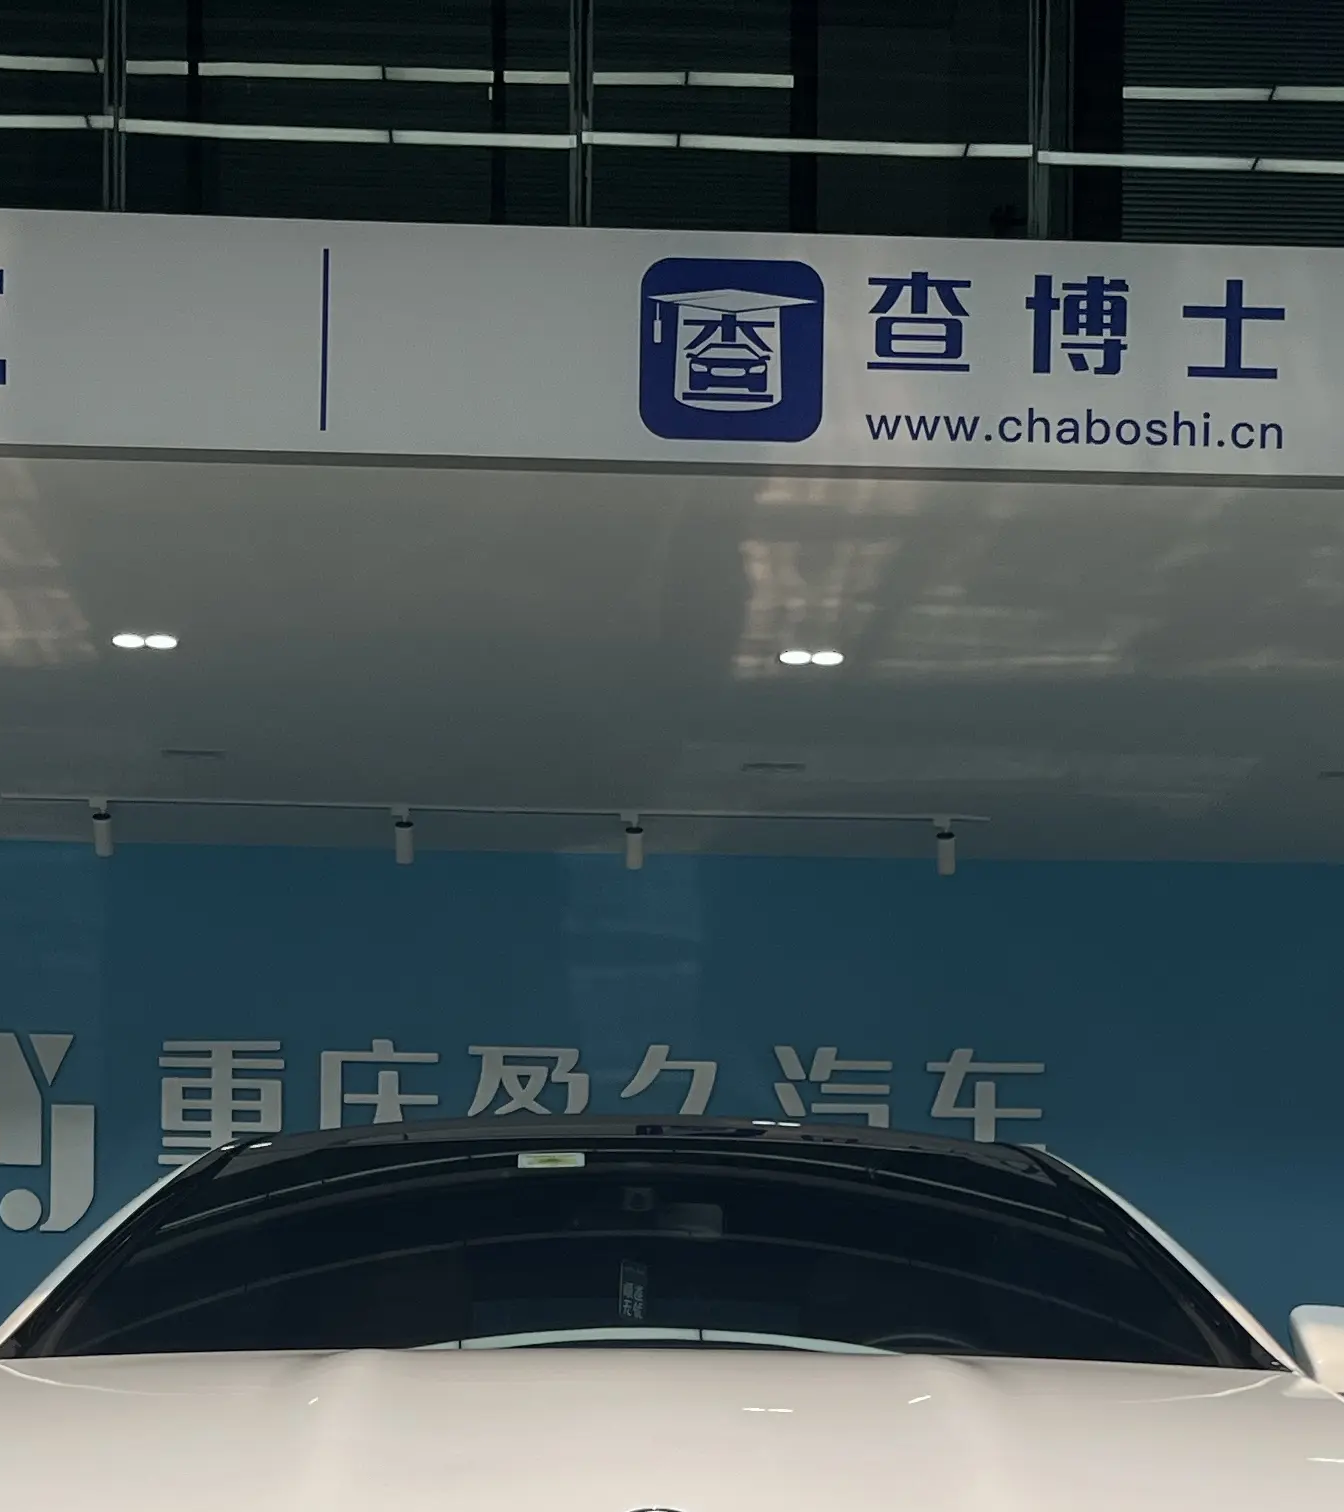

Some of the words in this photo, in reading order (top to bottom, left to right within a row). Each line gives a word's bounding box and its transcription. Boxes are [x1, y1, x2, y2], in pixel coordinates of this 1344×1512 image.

[866, 271, 1286, 380] 查博士
[865, 408, 1285, 451] www.chaboshi.cn
